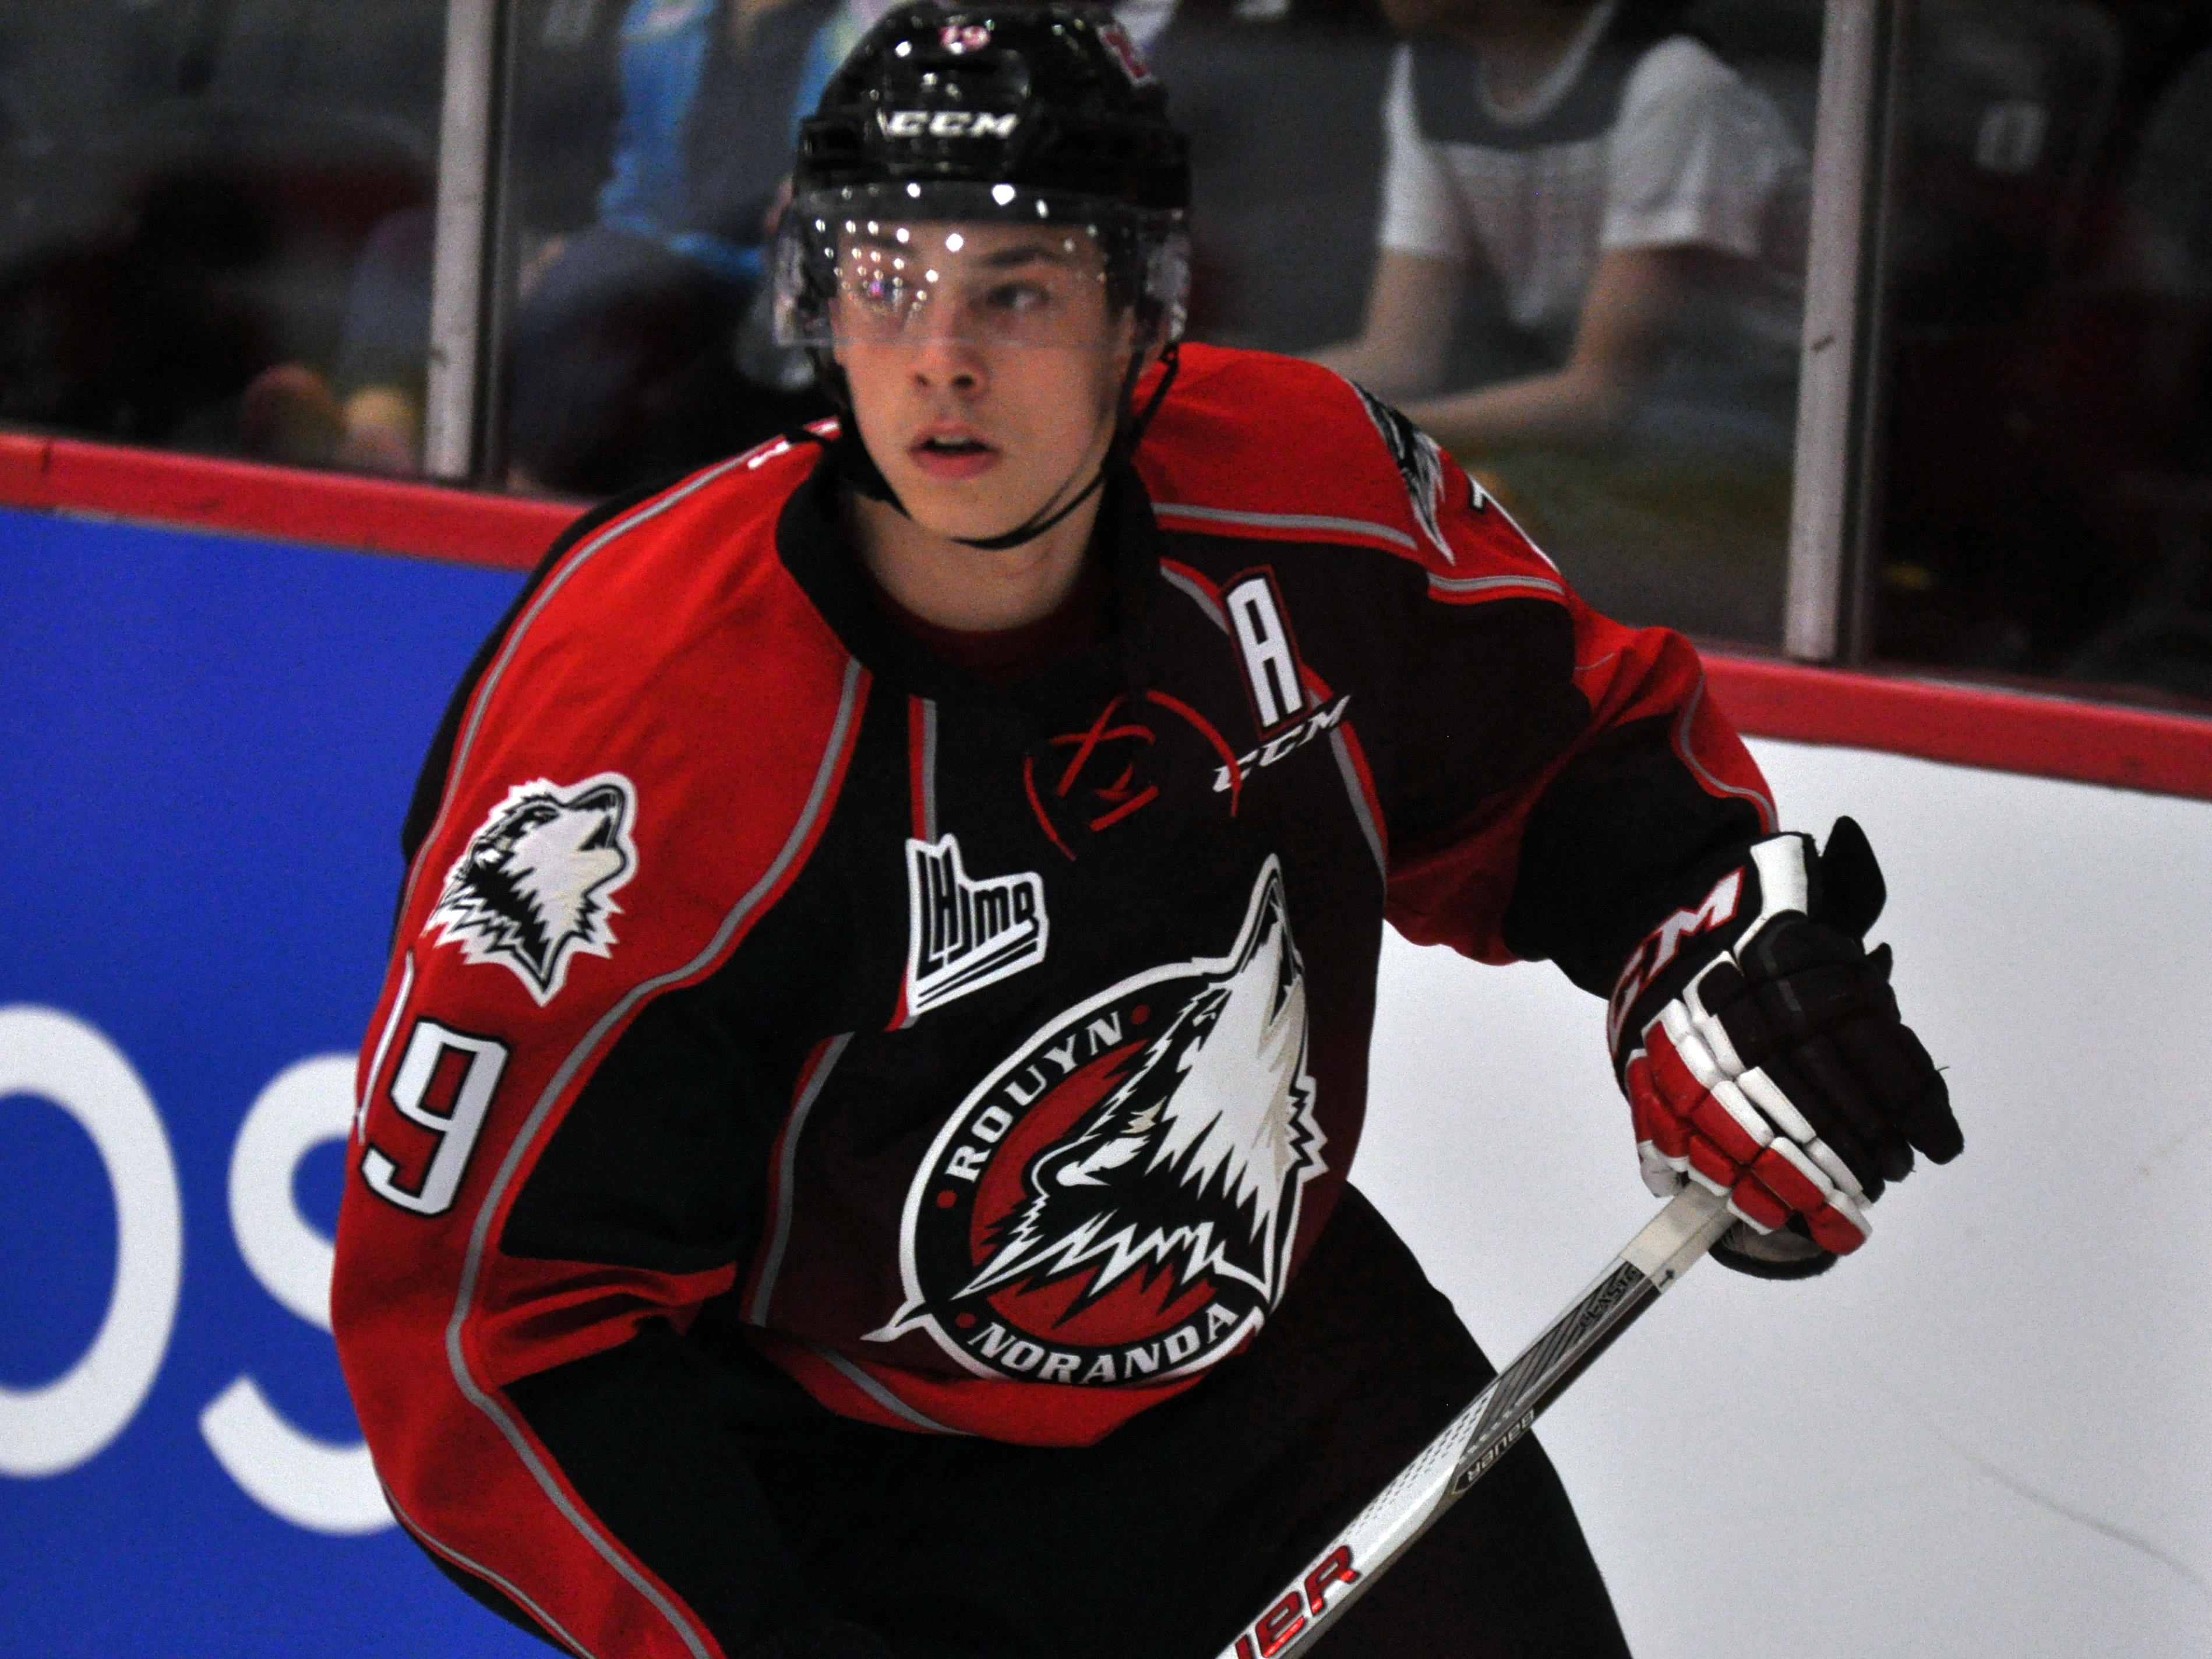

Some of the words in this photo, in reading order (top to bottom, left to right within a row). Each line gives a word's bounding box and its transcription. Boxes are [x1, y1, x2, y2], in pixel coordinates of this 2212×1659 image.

[887, 109, 1019, 139] CCM
[1225, 577, 1304, 728] A
[1212, 694, 1352, 793] CCM
[943, 1010, 1124, 1184] ROUYN
[966, 1301, 1239, 1385] NORANDA
